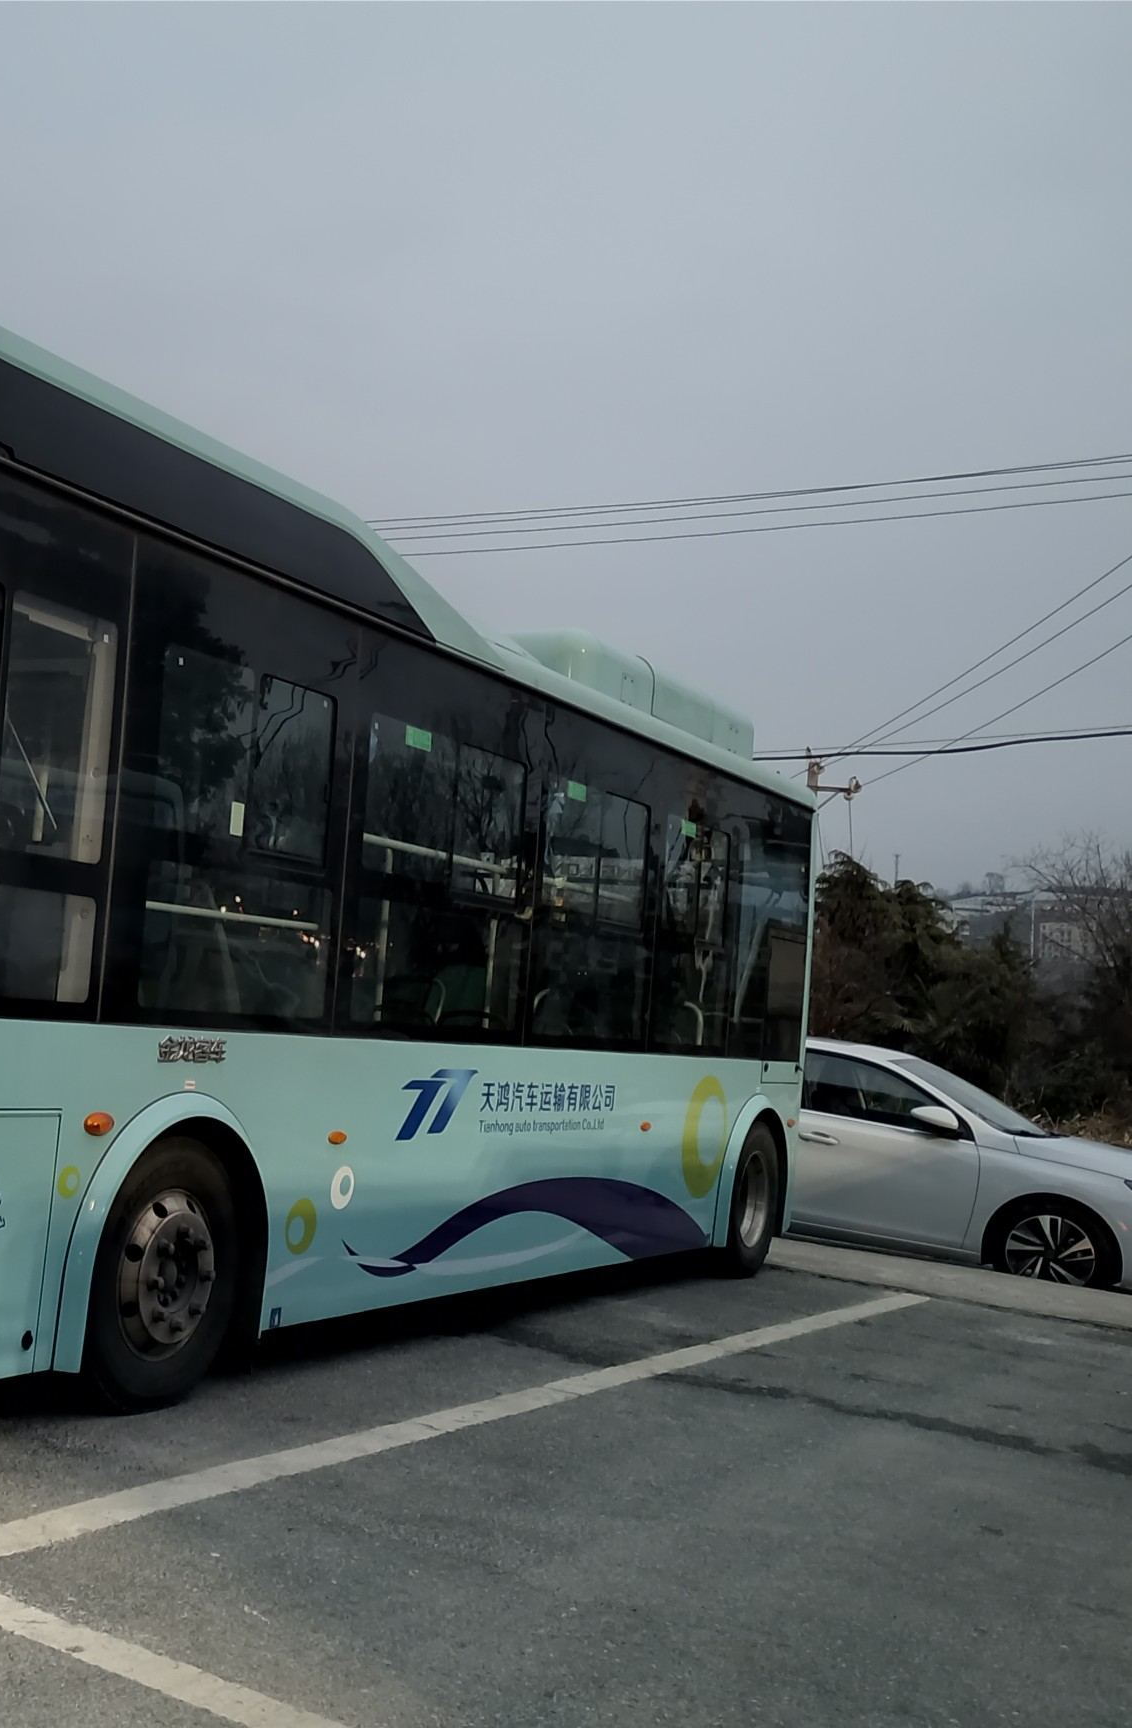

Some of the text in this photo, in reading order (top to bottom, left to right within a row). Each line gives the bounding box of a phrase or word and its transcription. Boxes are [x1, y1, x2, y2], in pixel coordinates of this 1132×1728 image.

[479, 1081, 616, 1113] 天鸿汽车运输有限公司
[479, 1120, 514, 1136] Tianhong
[514, 1120, 531, 1132] auto
[533, 1119, 581, 1134] transportation
